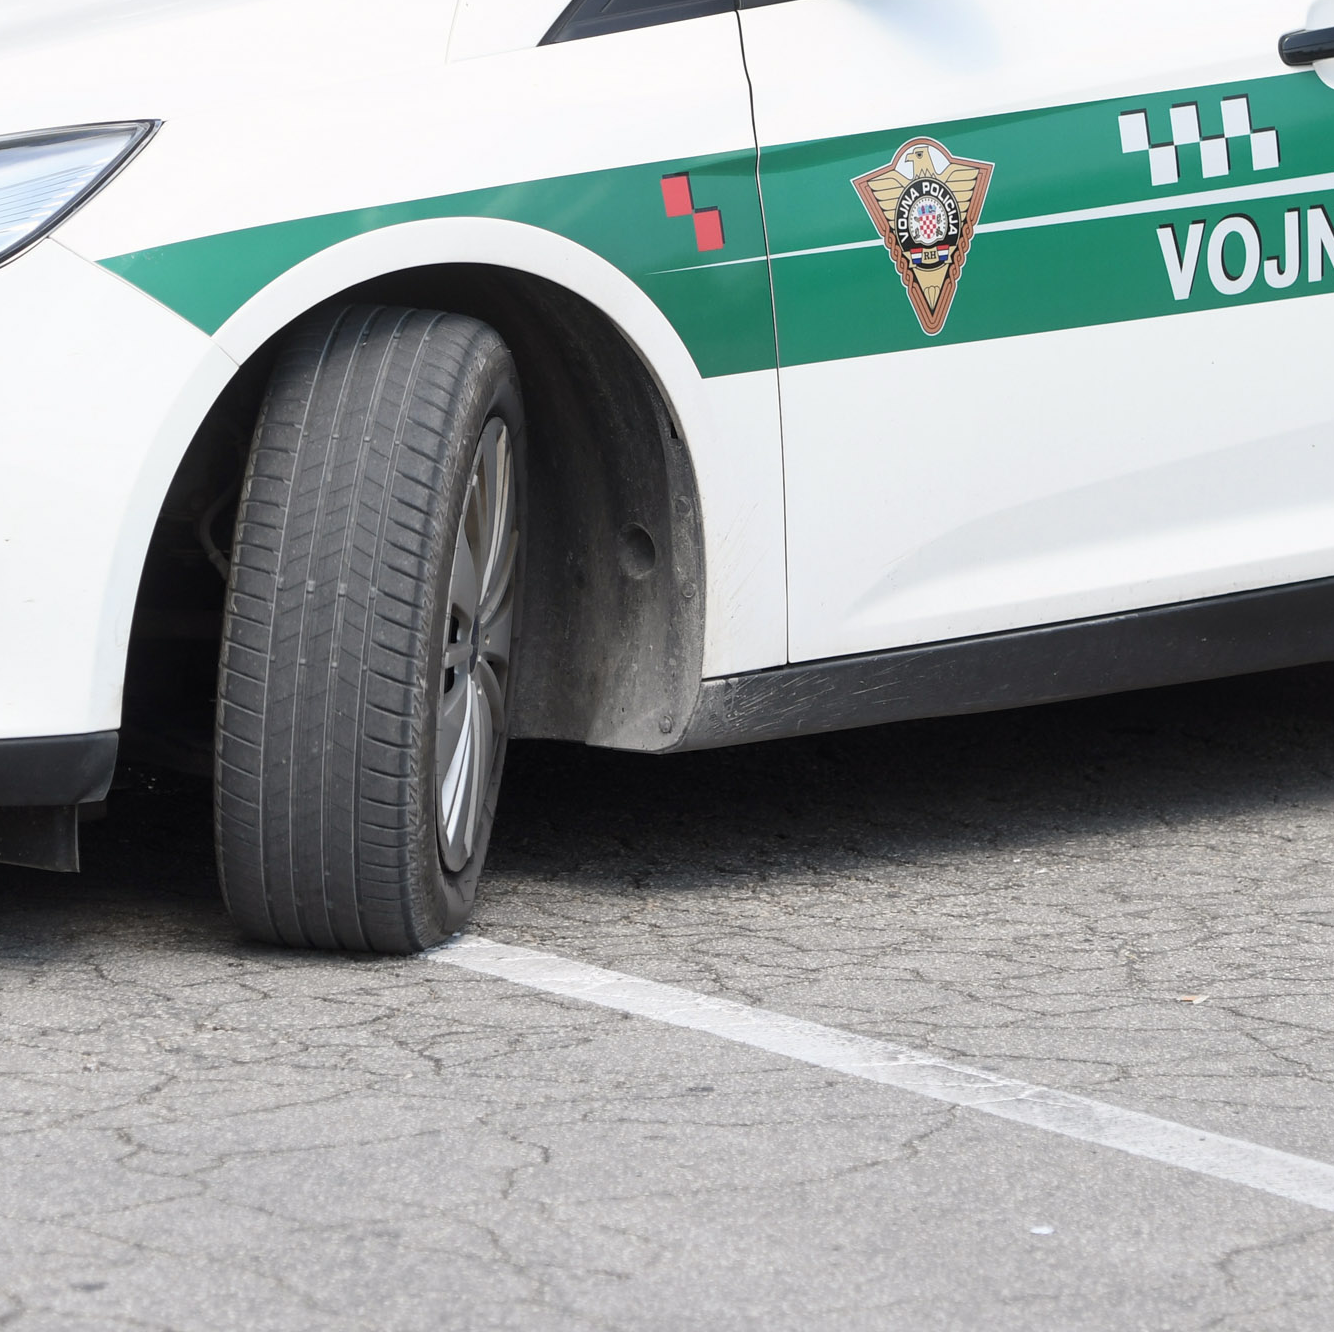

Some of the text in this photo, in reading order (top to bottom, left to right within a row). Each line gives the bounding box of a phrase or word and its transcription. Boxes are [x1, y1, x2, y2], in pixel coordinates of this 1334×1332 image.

[898, 181, 958, 243] VOJNA POLICIJA
[923, 250, 937, 260] RH
